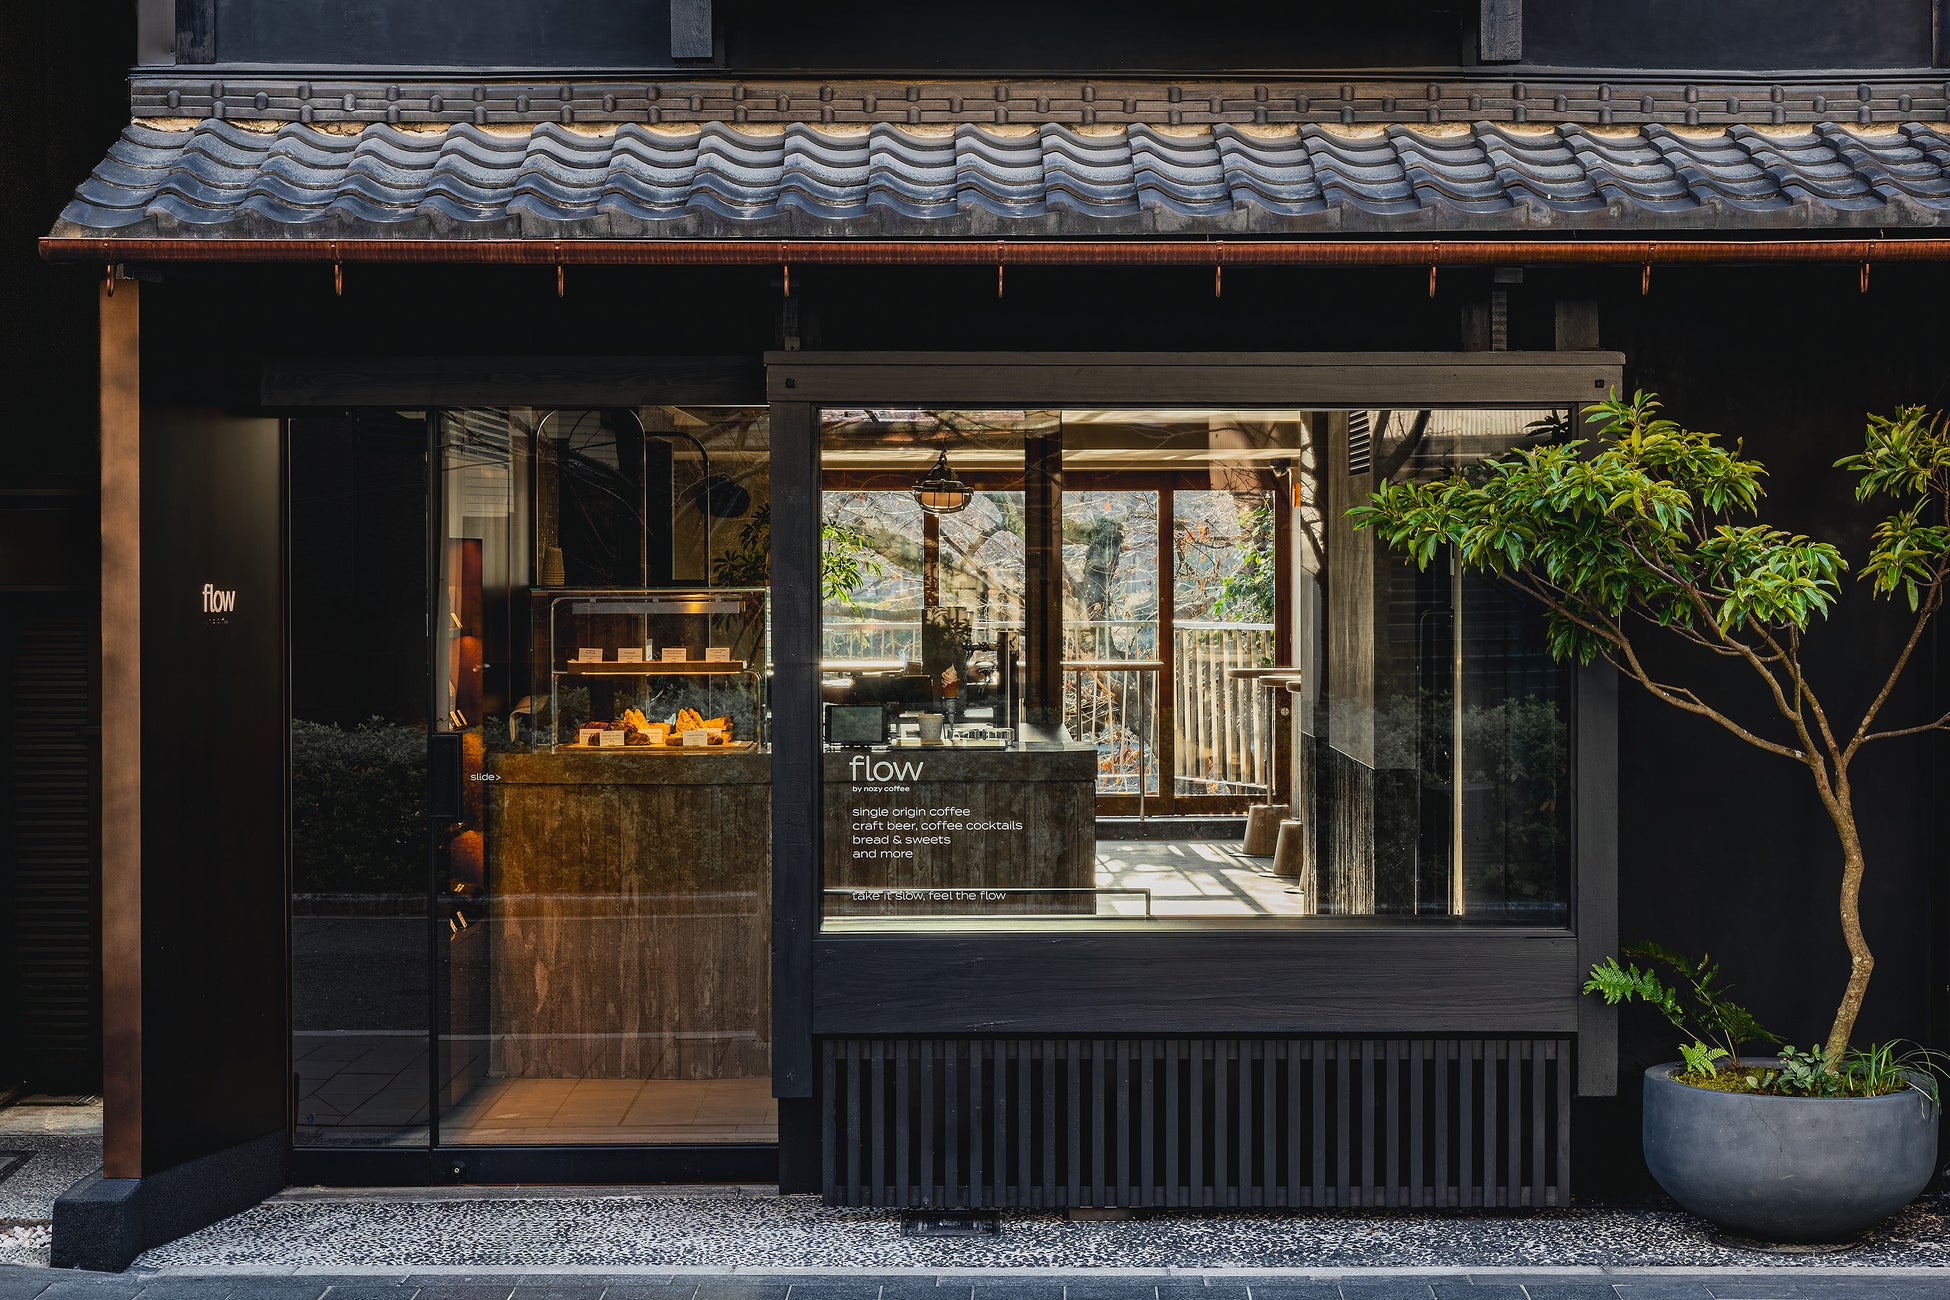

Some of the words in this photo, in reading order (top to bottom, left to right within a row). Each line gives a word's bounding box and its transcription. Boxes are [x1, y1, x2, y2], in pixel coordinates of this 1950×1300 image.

[203, 583, 236, 612] flow
[849, 755, 924, 782] flow
[852, 785, 862, 793] by
[852, 806, 889, 818] single
[892, 806, 926, 818] origin
[929, 806, 971, 817] coffee
[852, 820, 884, 831] craft
[887, 820, 918, 832] beer,
[921, 820, 963, 831] coffee
[966, 820, 1023, 831] cocktails
[852, 834, 890, 845] bread
[892, 835, 902, 845] &
[905, 835, 951, 845] sweets
[852, 848, 877, 859] and
[880, 850, 914, 859] more
[852, 890, 880, 901] take
[883, 890, 891, 901] it
[895, 890, 926, 902] slow,
[928, 890, 953, 901] feel
[955, 890, 977, 901] the
[979, 890, 1007, 901] flow
